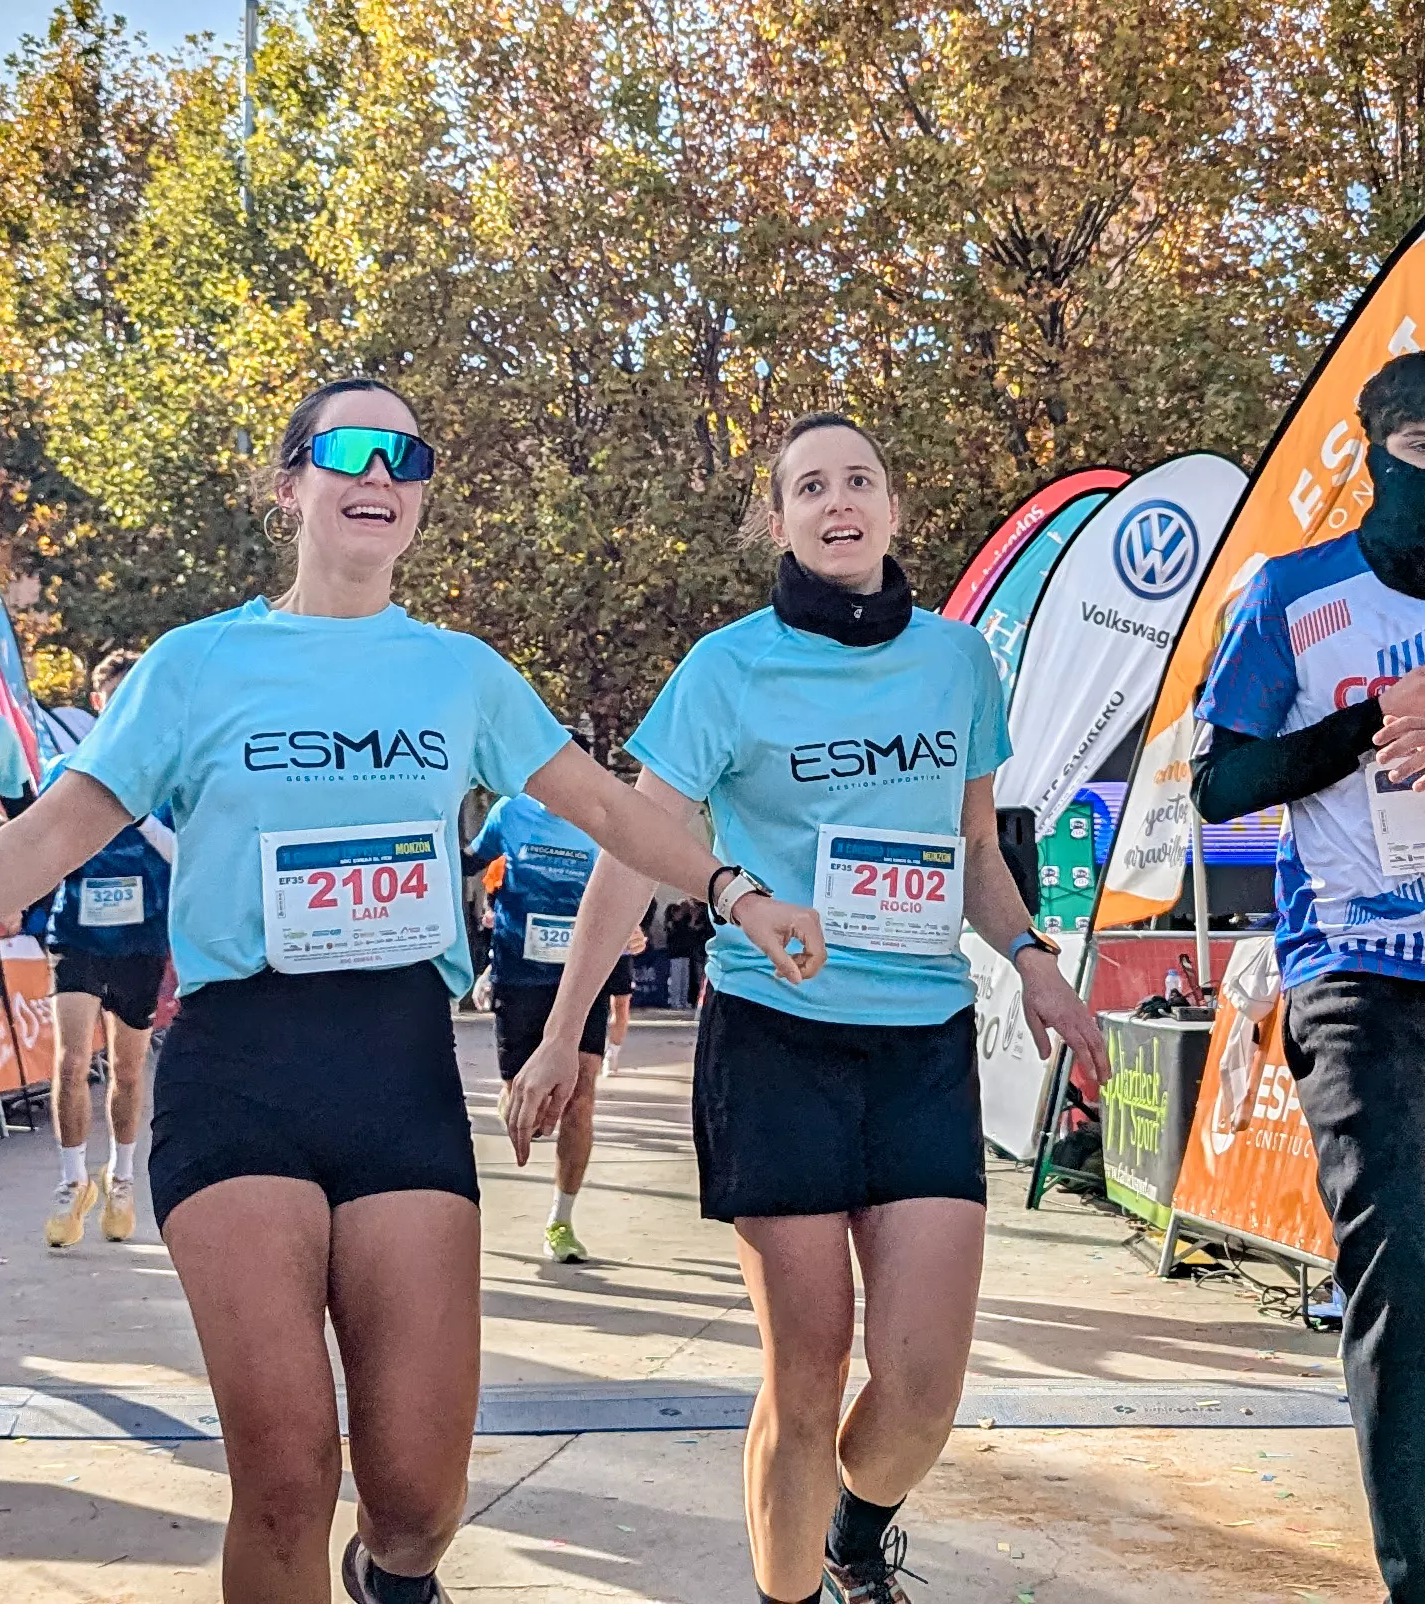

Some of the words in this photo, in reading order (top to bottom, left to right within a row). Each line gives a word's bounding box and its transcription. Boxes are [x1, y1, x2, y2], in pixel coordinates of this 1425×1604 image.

[1082, 601, 1175, 650] Volkswag
[245, 729, 449, 771] ESMAS
[791, 730, 958, 783] ESMAS
[353, 773, 426, 781] DEPORTIVA
[395, 837, 432, 855] MONZÓN
[93, 888, 134, 903] 3203
[278, 876, 305, 886] EF35
[307, 863, 428, 910] 2104
[830, 863, 853, 872] EF35
[852, 864, 946, 902] 2102
[351, 906, 390, 921] LAIA
[880, 900, 923, 914] ROCIO
[539, 929, 574, 943] 320
[1253, 1063, 1310, 1127] ESP
